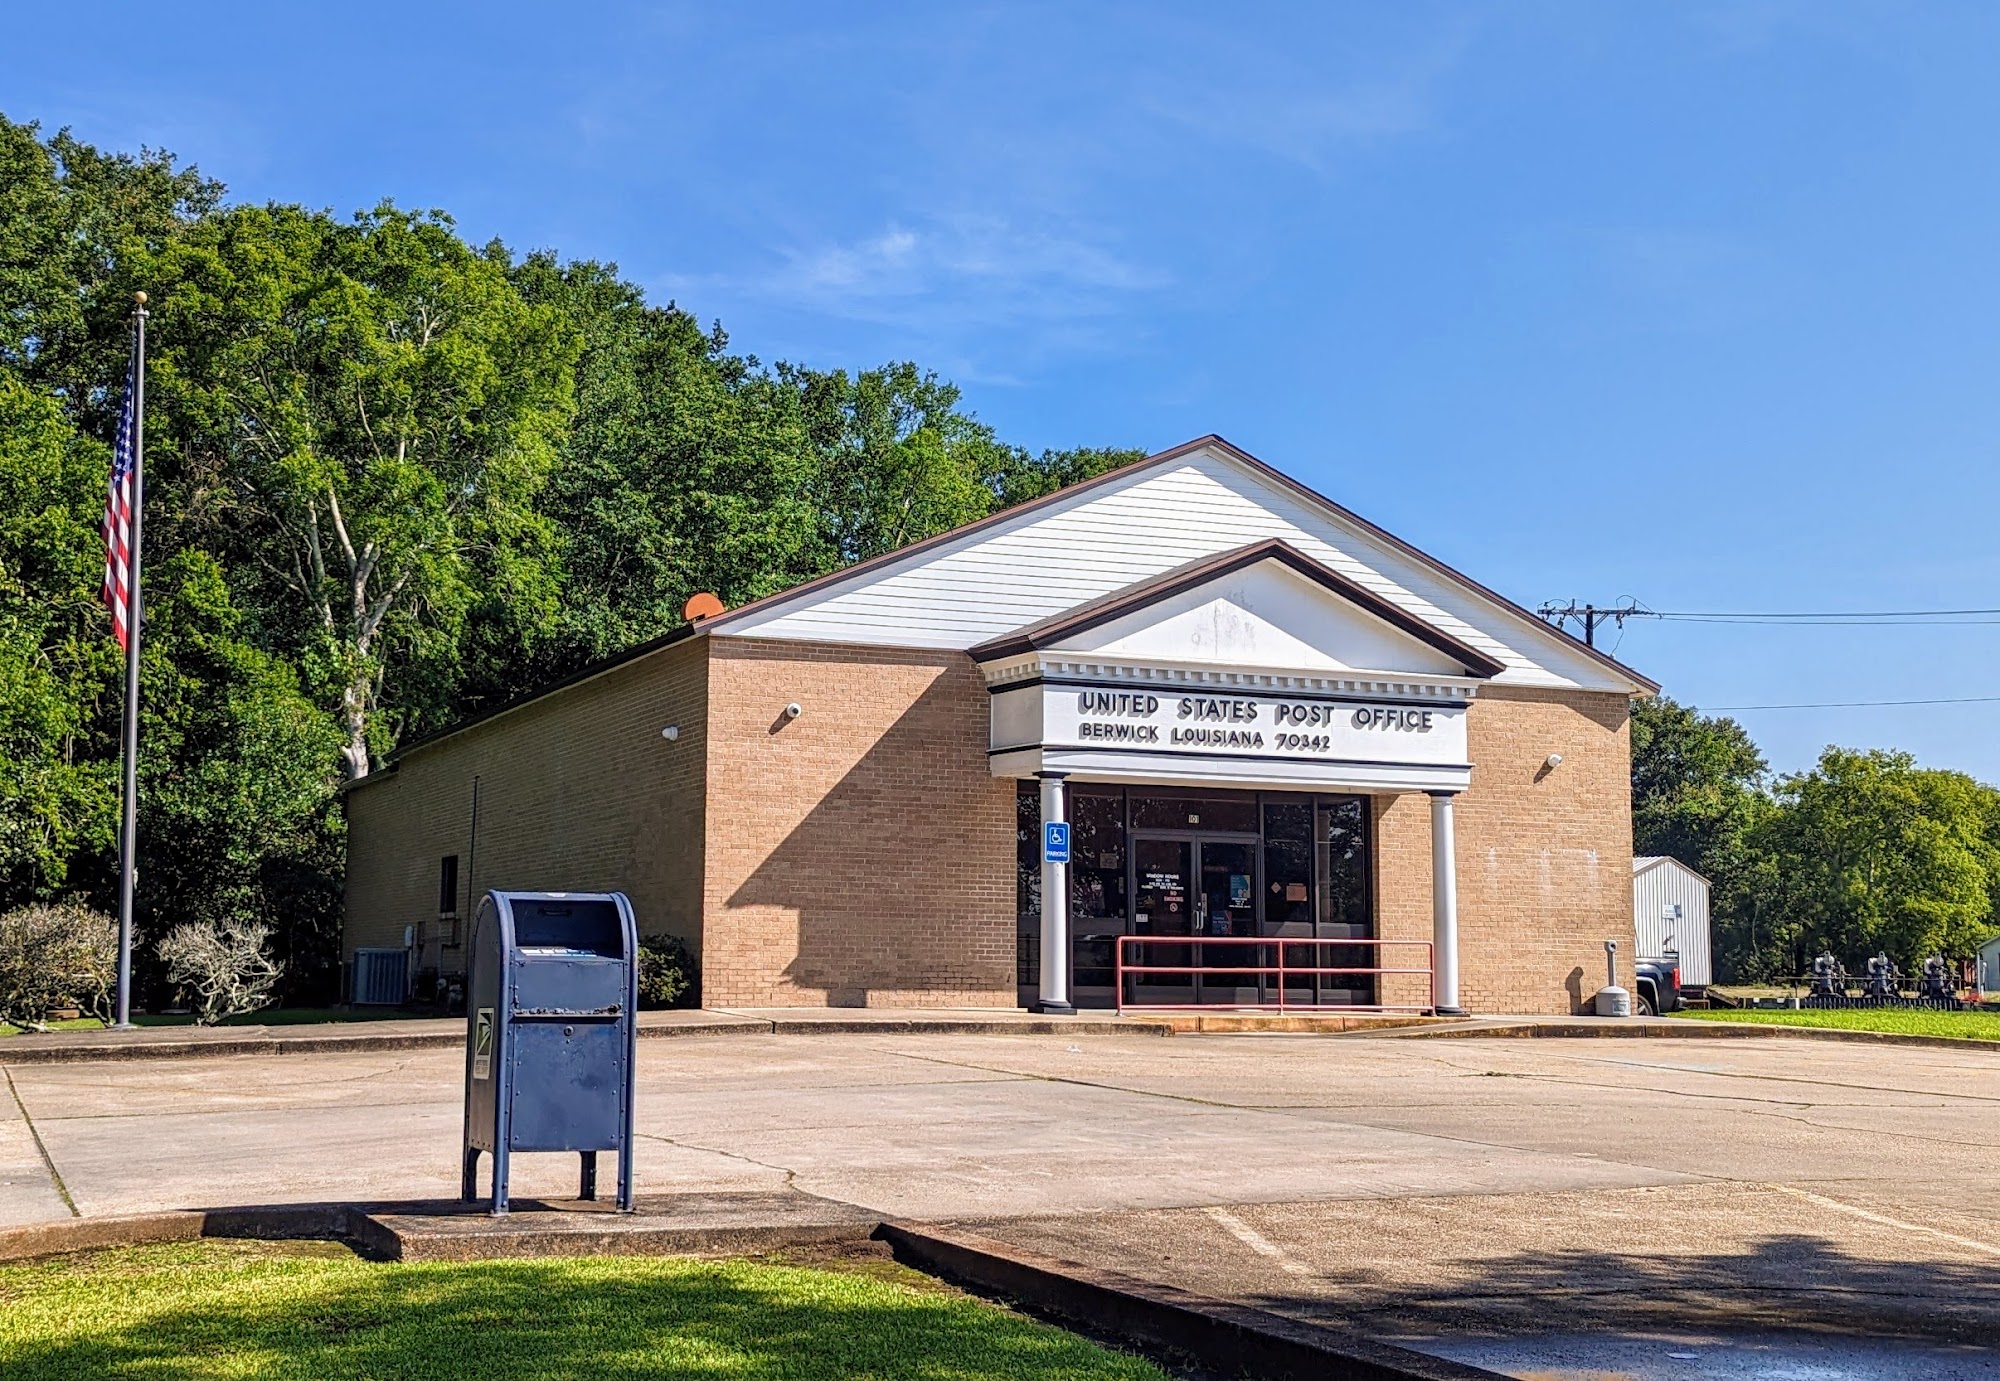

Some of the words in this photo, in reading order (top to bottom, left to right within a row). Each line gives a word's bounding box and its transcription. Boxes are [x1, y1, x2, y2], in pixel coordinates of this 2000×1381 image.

[1082, 691, 1159, 714] UNITED
[1181, 697, 1258, 720] STATES
[1279, 703, 1335, 724] POST
[1356, 707, 1433, 729] OFFICE
[1081, 722, 1160, 740] BERWICK
[1173, 727, 1264, 746] LOUISIANA
[1278, 733, 1331, 749] 70342
[1046, 850, 1068, 858] PARKING
